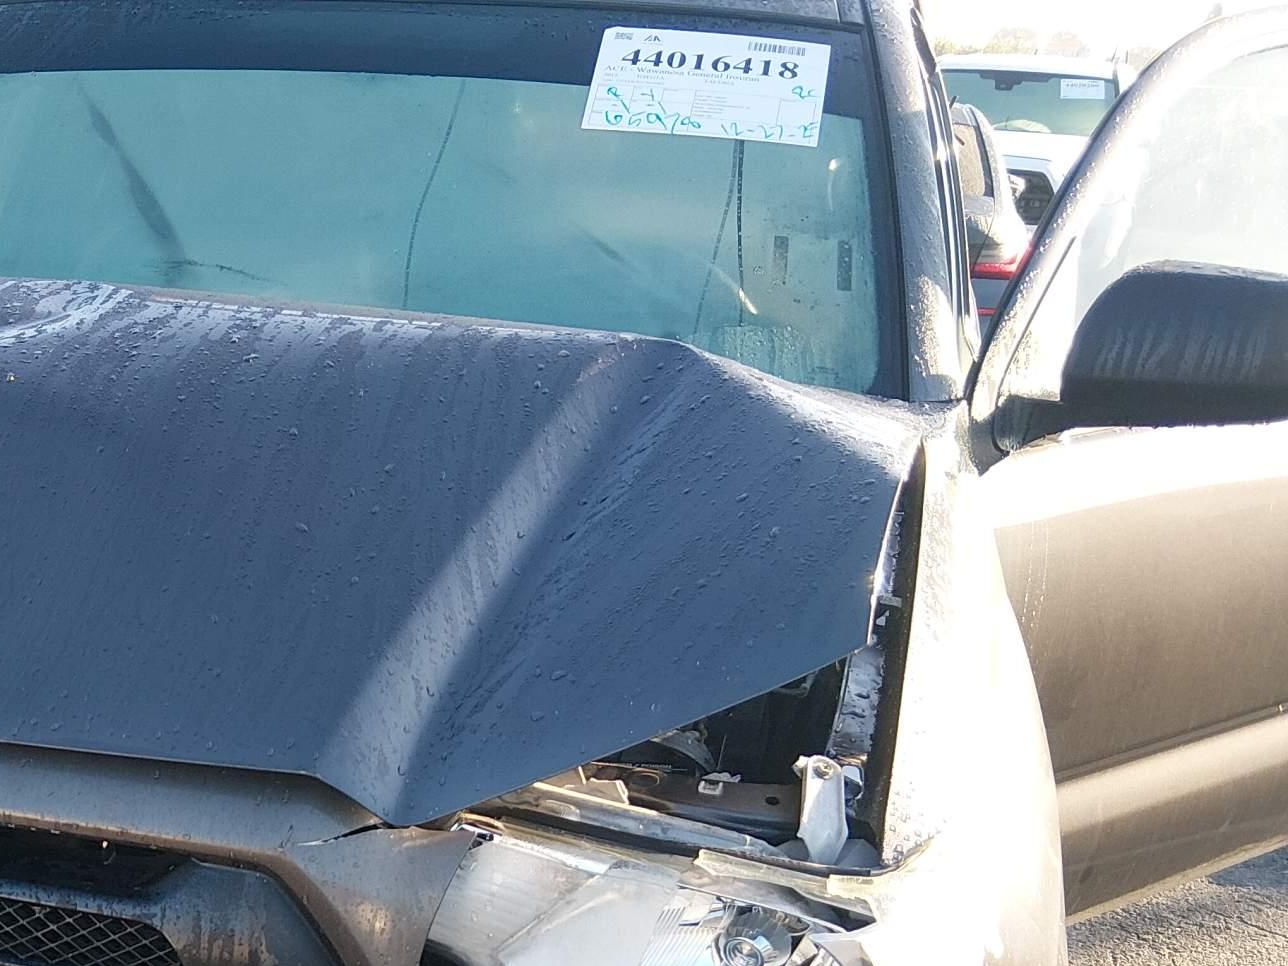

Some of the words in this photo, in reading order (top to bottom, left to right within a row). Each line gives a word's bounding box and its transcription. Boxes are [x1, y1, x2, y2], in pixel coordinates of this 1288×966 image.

[605, 65, 628, 73] ACE
[687, 69, 724, 79] General
[621, 48, 800, 80] 44016418
